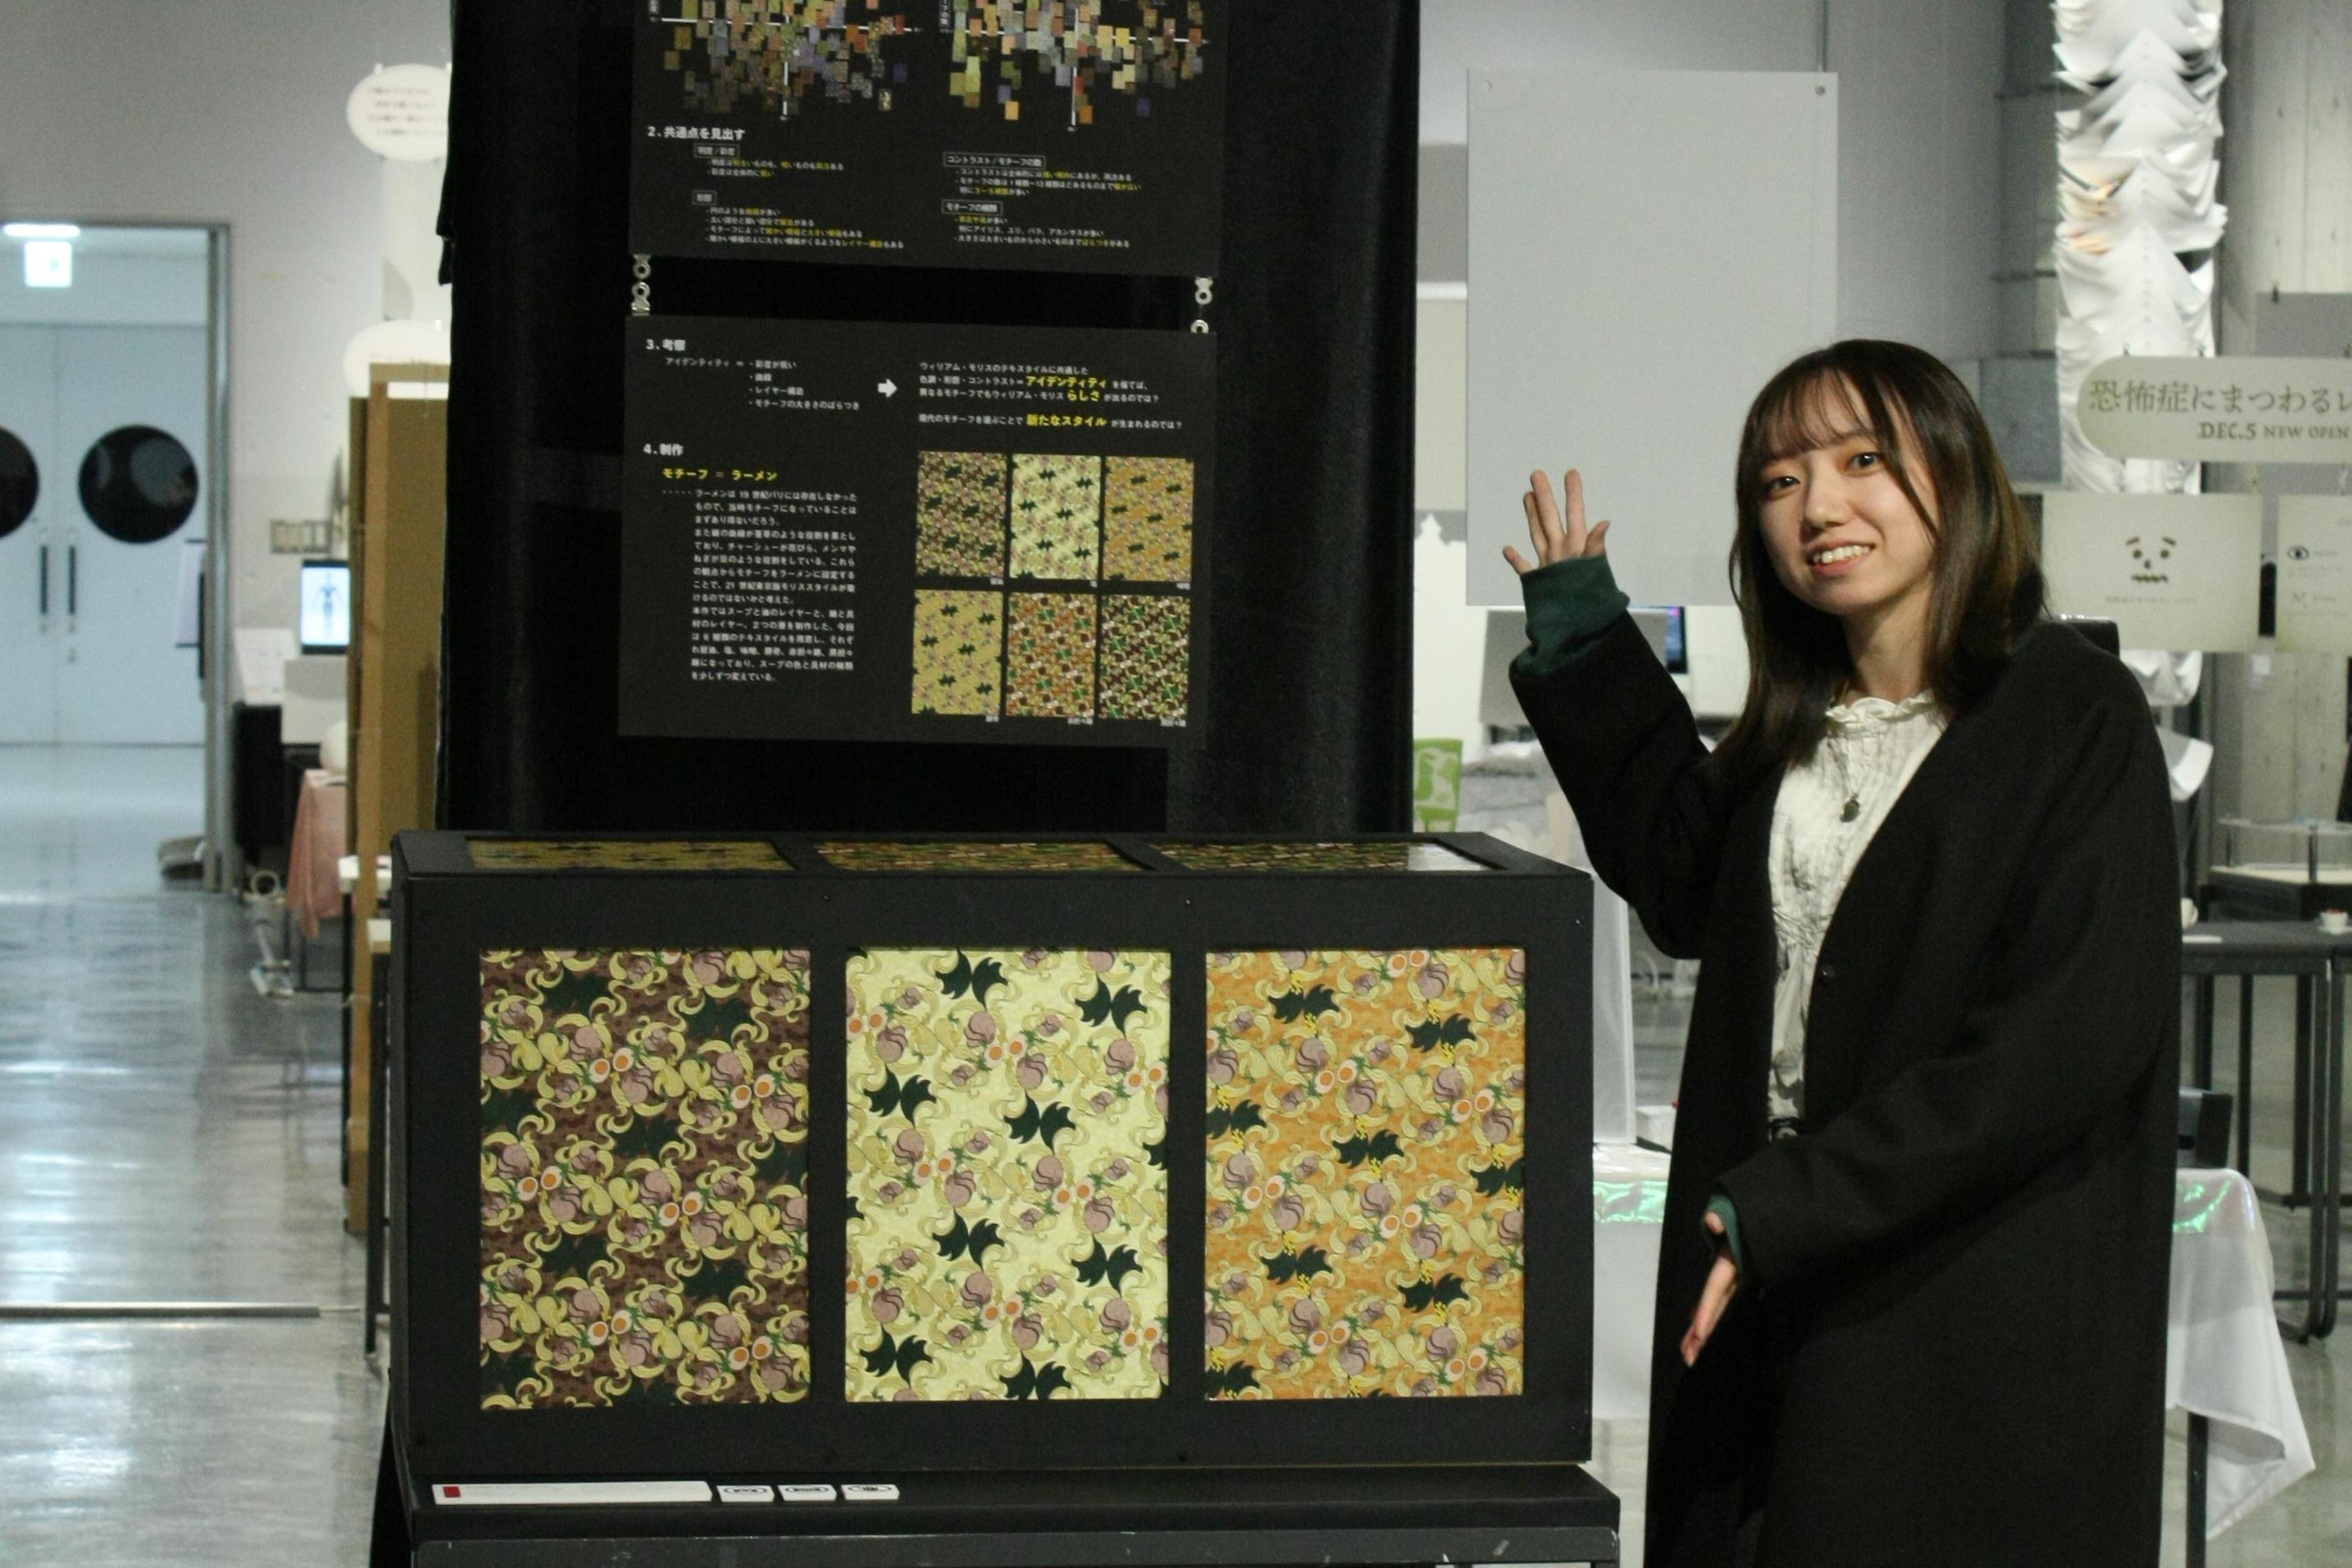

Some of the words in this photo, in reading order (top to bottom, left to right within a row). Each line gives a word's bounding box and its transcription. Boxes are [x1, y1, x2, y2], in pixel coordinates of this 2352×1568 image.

[1066, 390, 1100, 402] らしさ
[2199, 421, 2257, 440] DEC.5
[2264, 425, 2301, 439] NEW
[2308, 426, 2351, 439] OPEN
[663, 468, 708, 480] モチーフ
[731, 469, 778, 481] ラーメン
